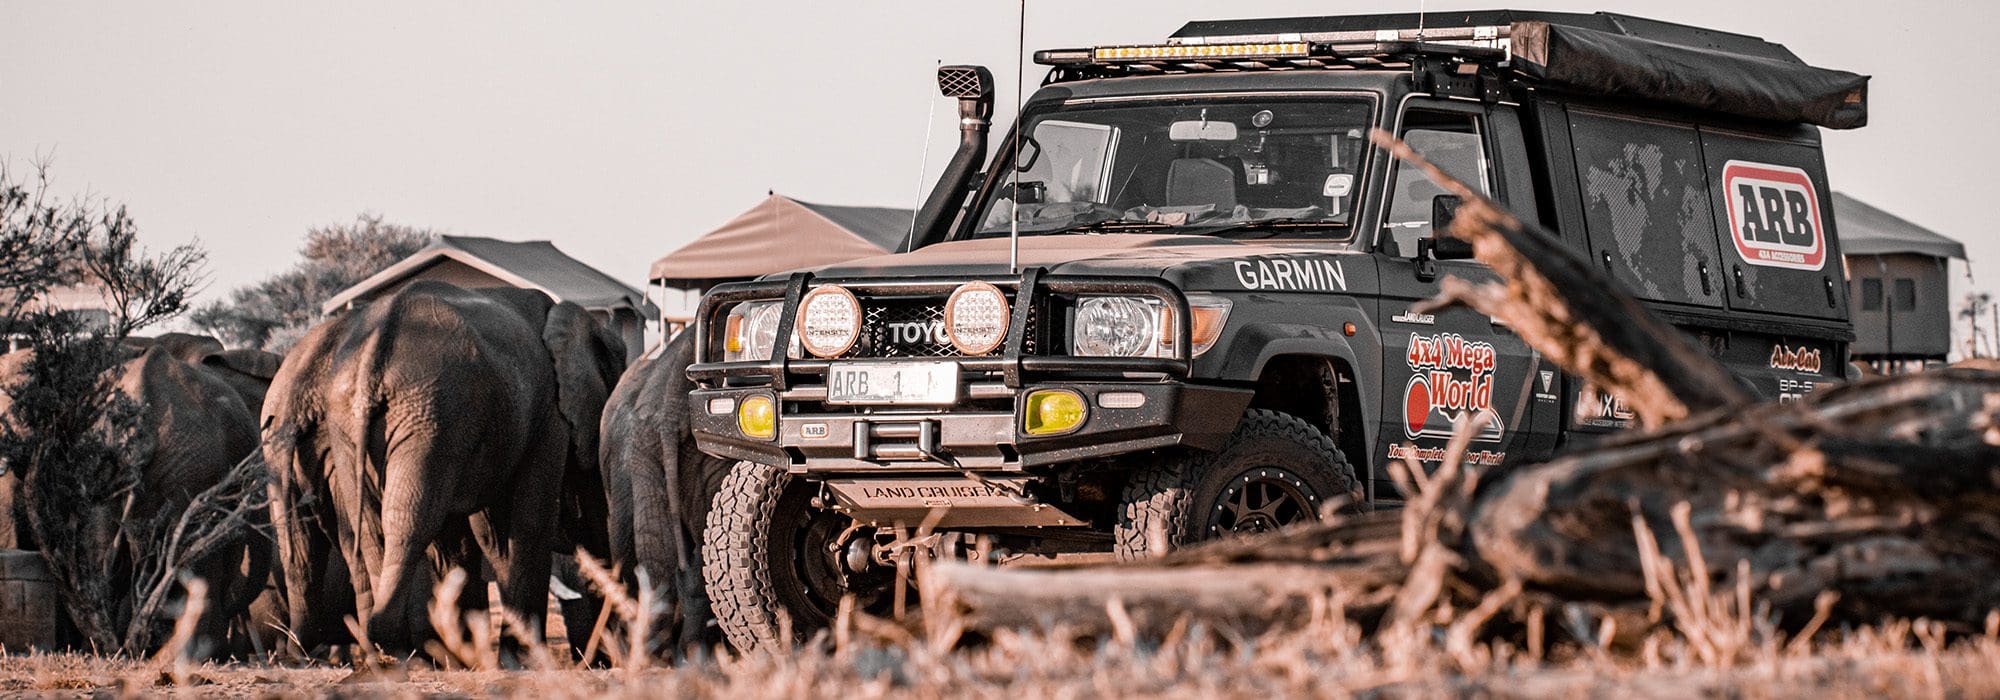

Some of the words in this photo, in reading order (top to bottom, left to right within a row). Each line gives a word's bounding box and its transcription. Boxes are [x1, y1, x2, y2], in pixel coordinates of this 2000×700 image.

[1738, 184, 1815, 247] ARB
[1234, 259, 1347, 291] GARMIN
[888, 321, 950, 345] TOYO
[1408, 336, 1442, 368] 4x4
[1444, 337, 1494, 375] Mega
[832, 371, 869, 397] ARB
[1430, 371, 1492, 411] World
[805, 426, 826, 435] ARB
[863, 486, 915, 499] LAND
